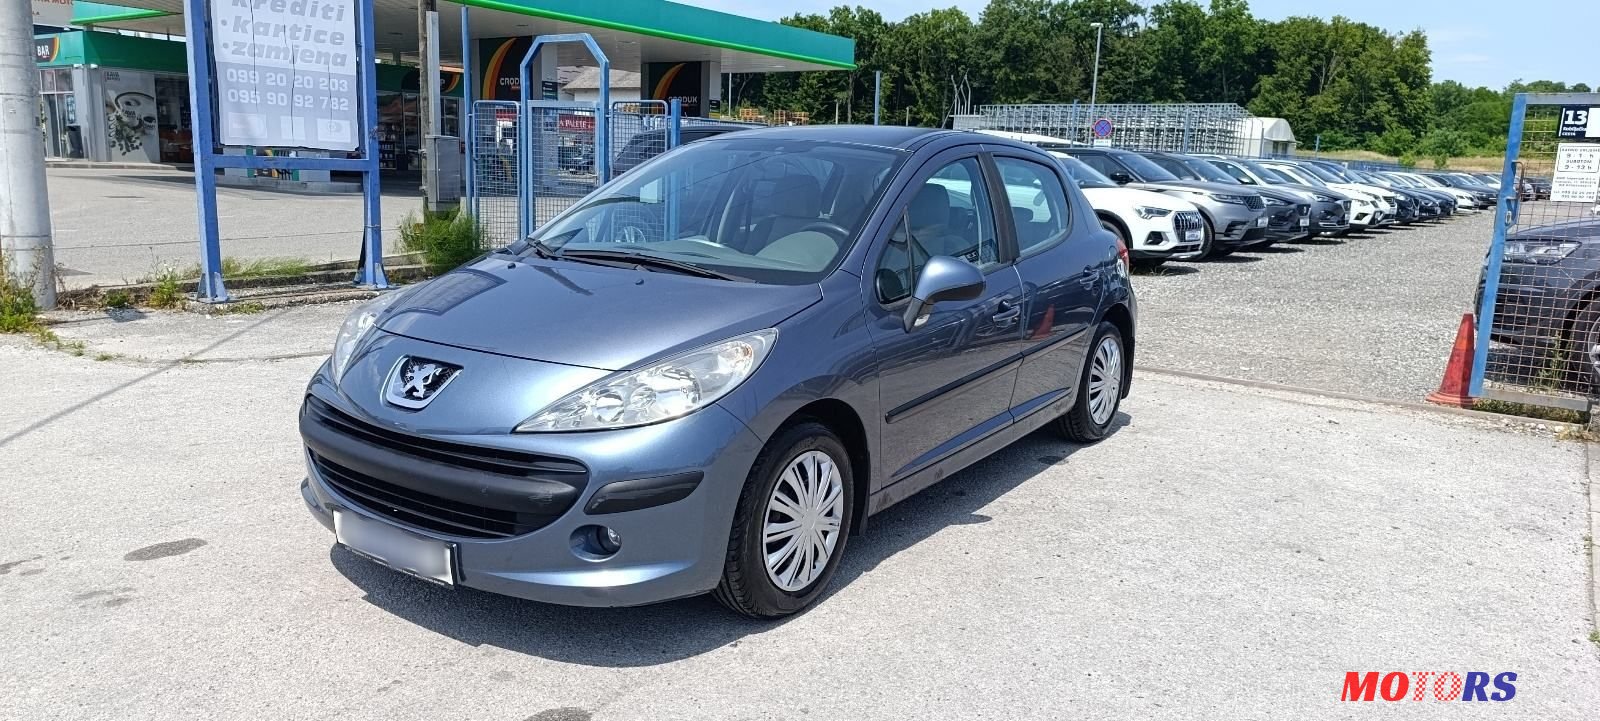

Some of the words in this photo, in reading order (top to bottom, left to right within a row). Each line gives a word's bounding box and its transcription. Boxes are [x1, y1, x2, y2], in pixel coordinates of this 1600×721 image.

[232, 15, 345, 46] kartice
[37, 45, 50, 56] BAR
[231, 41, 347, 67] zamjena
[226, 68, 259, 84] 099
[265, 72, 287, 87] 20
[294, 75, 314, 89] 20
[319, 77, 348, 92] 203
[500, 77, 520, 86] CROD
[227, 88, 260, 104] 095
[266, 91, 287, 106] 90
[294, 94, 314, 108] 92
[320, 96, 349, 111] 782
[1564, 110, 1587, 125] 13
